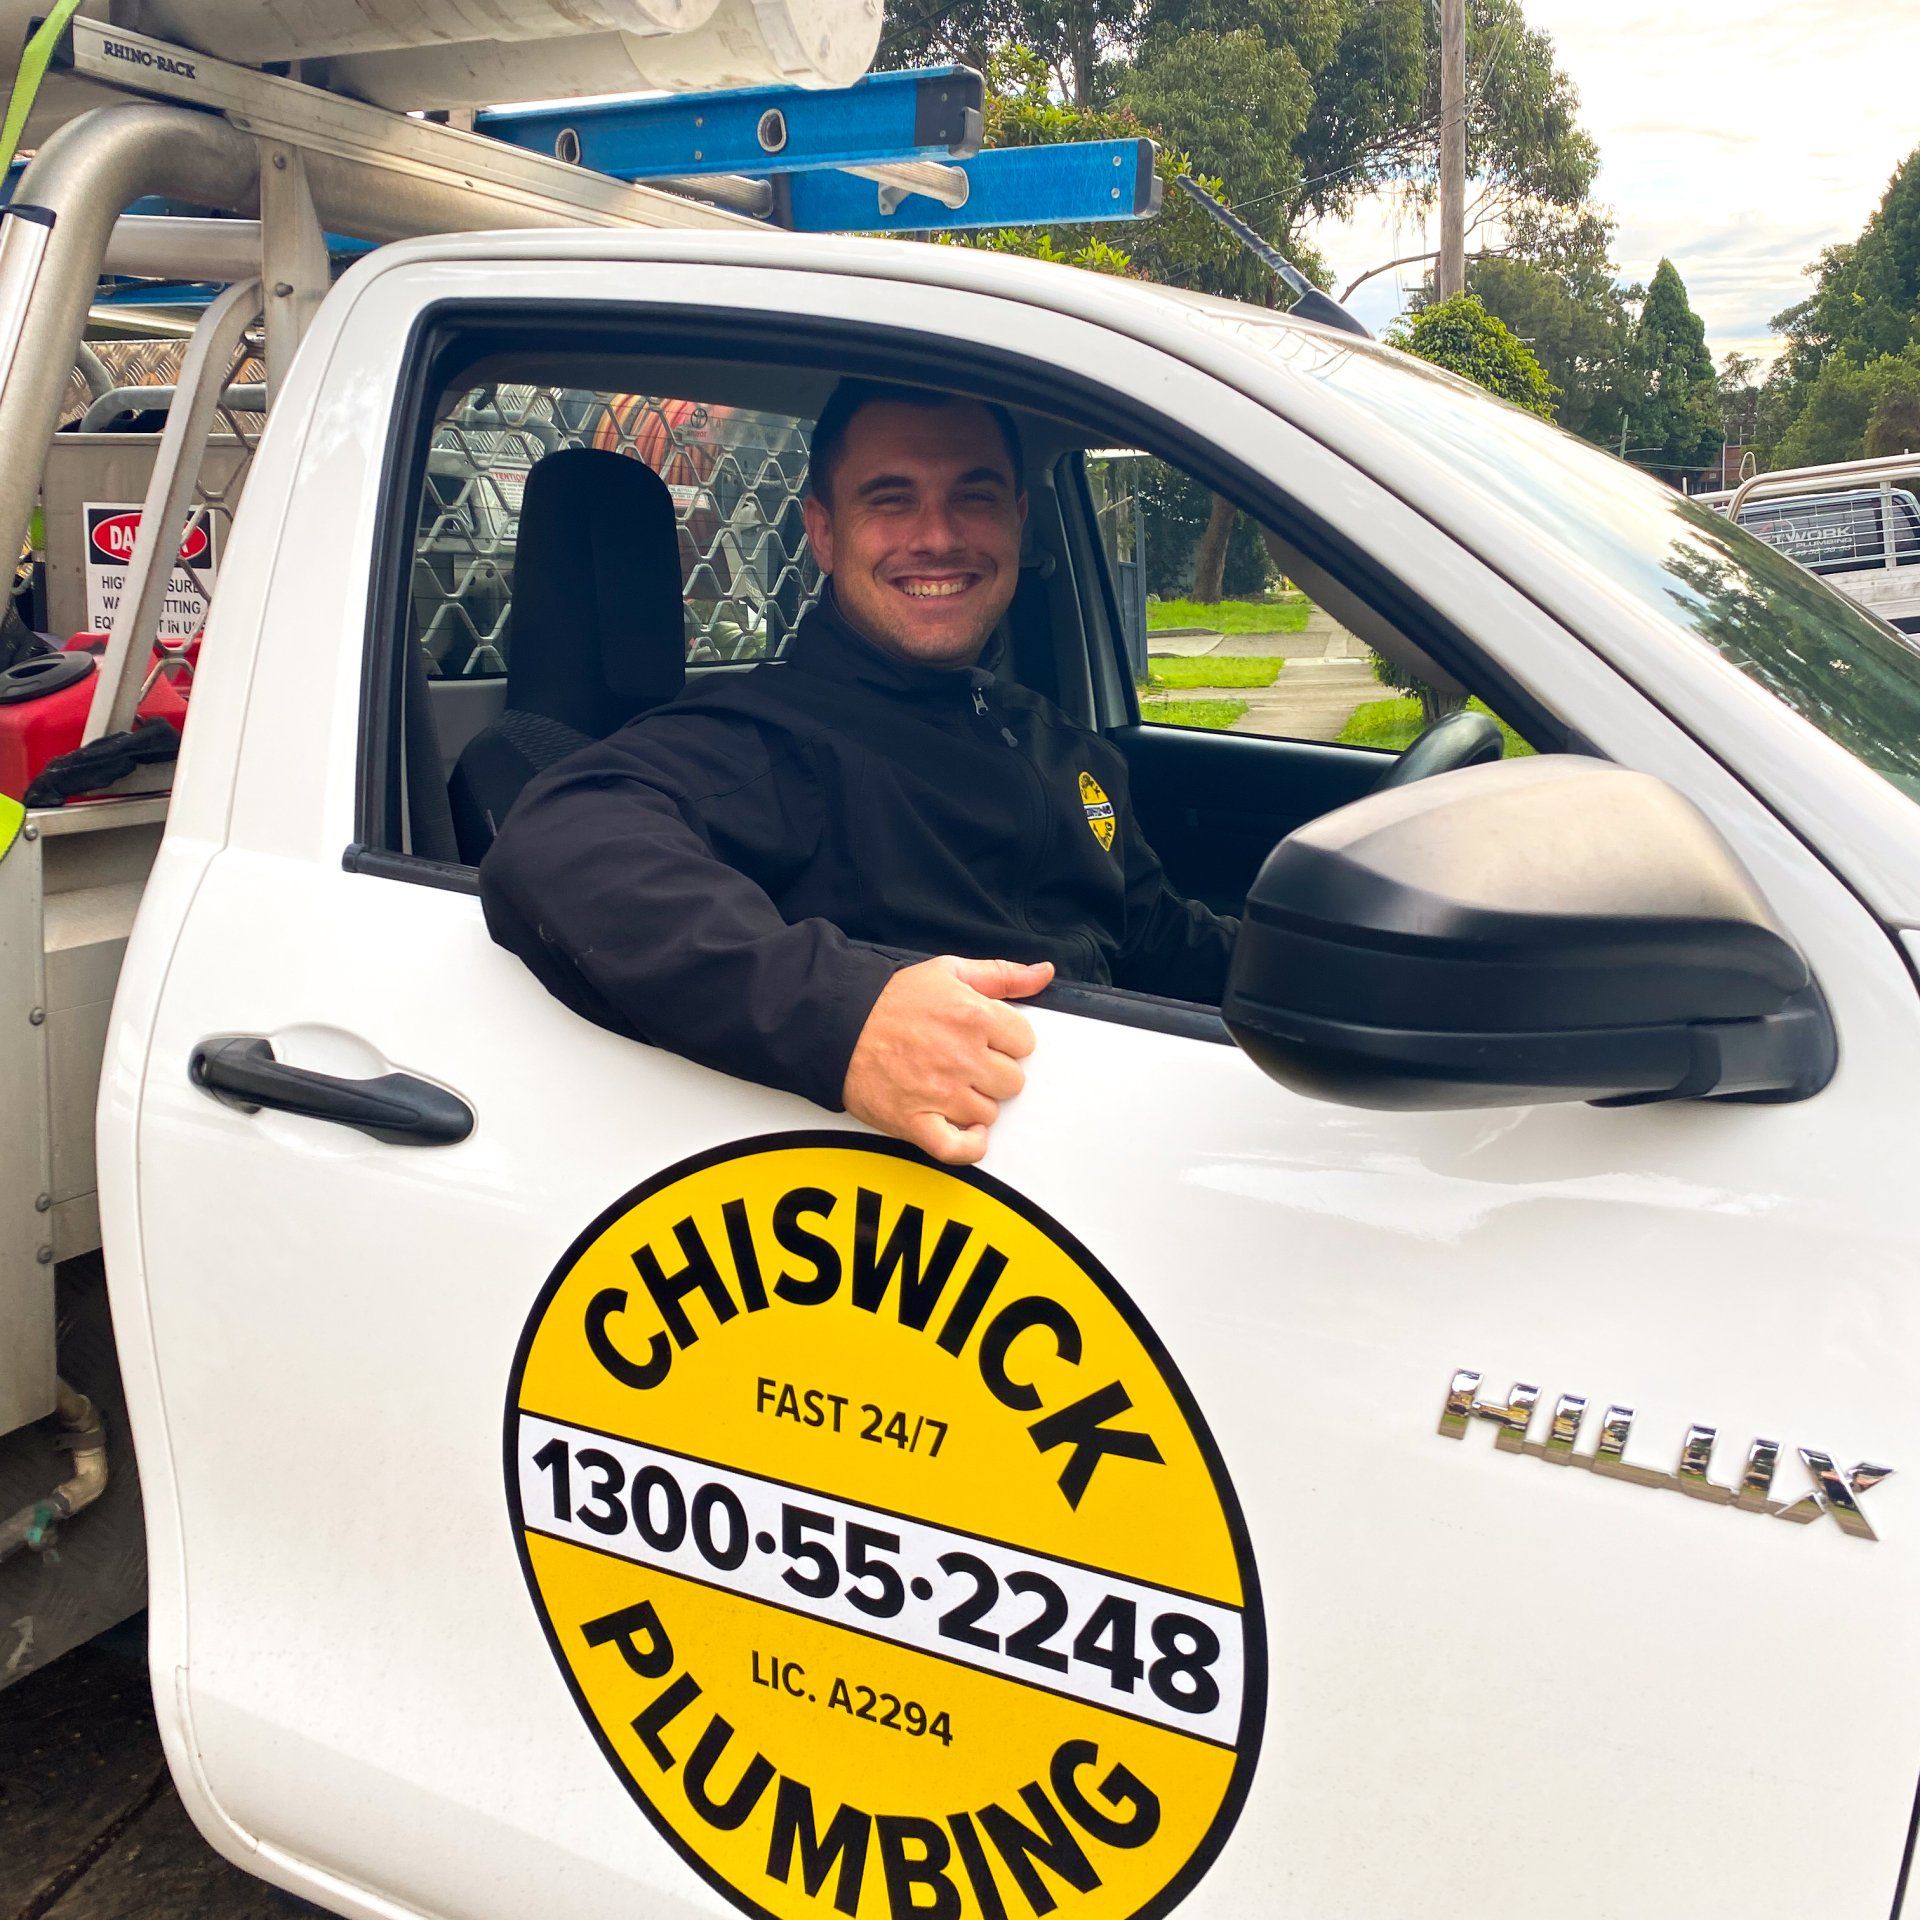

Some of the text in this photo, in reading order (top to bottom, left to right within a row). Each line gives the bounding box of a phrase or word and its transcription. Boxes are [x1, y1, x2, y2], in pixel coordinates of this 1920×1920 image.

[103, 40, 196, 80] RHINO-RACK
[584, 1186, 1167, 1513] CHISWICK
[755, 1376, 950, 1459] FAST 24/7
[1438, 1368, 1897, 1541] HILUX
[580, 1600, 1162, 1920] PLUMBING
[751, 1650, 954, 1747] LIC. A2294
